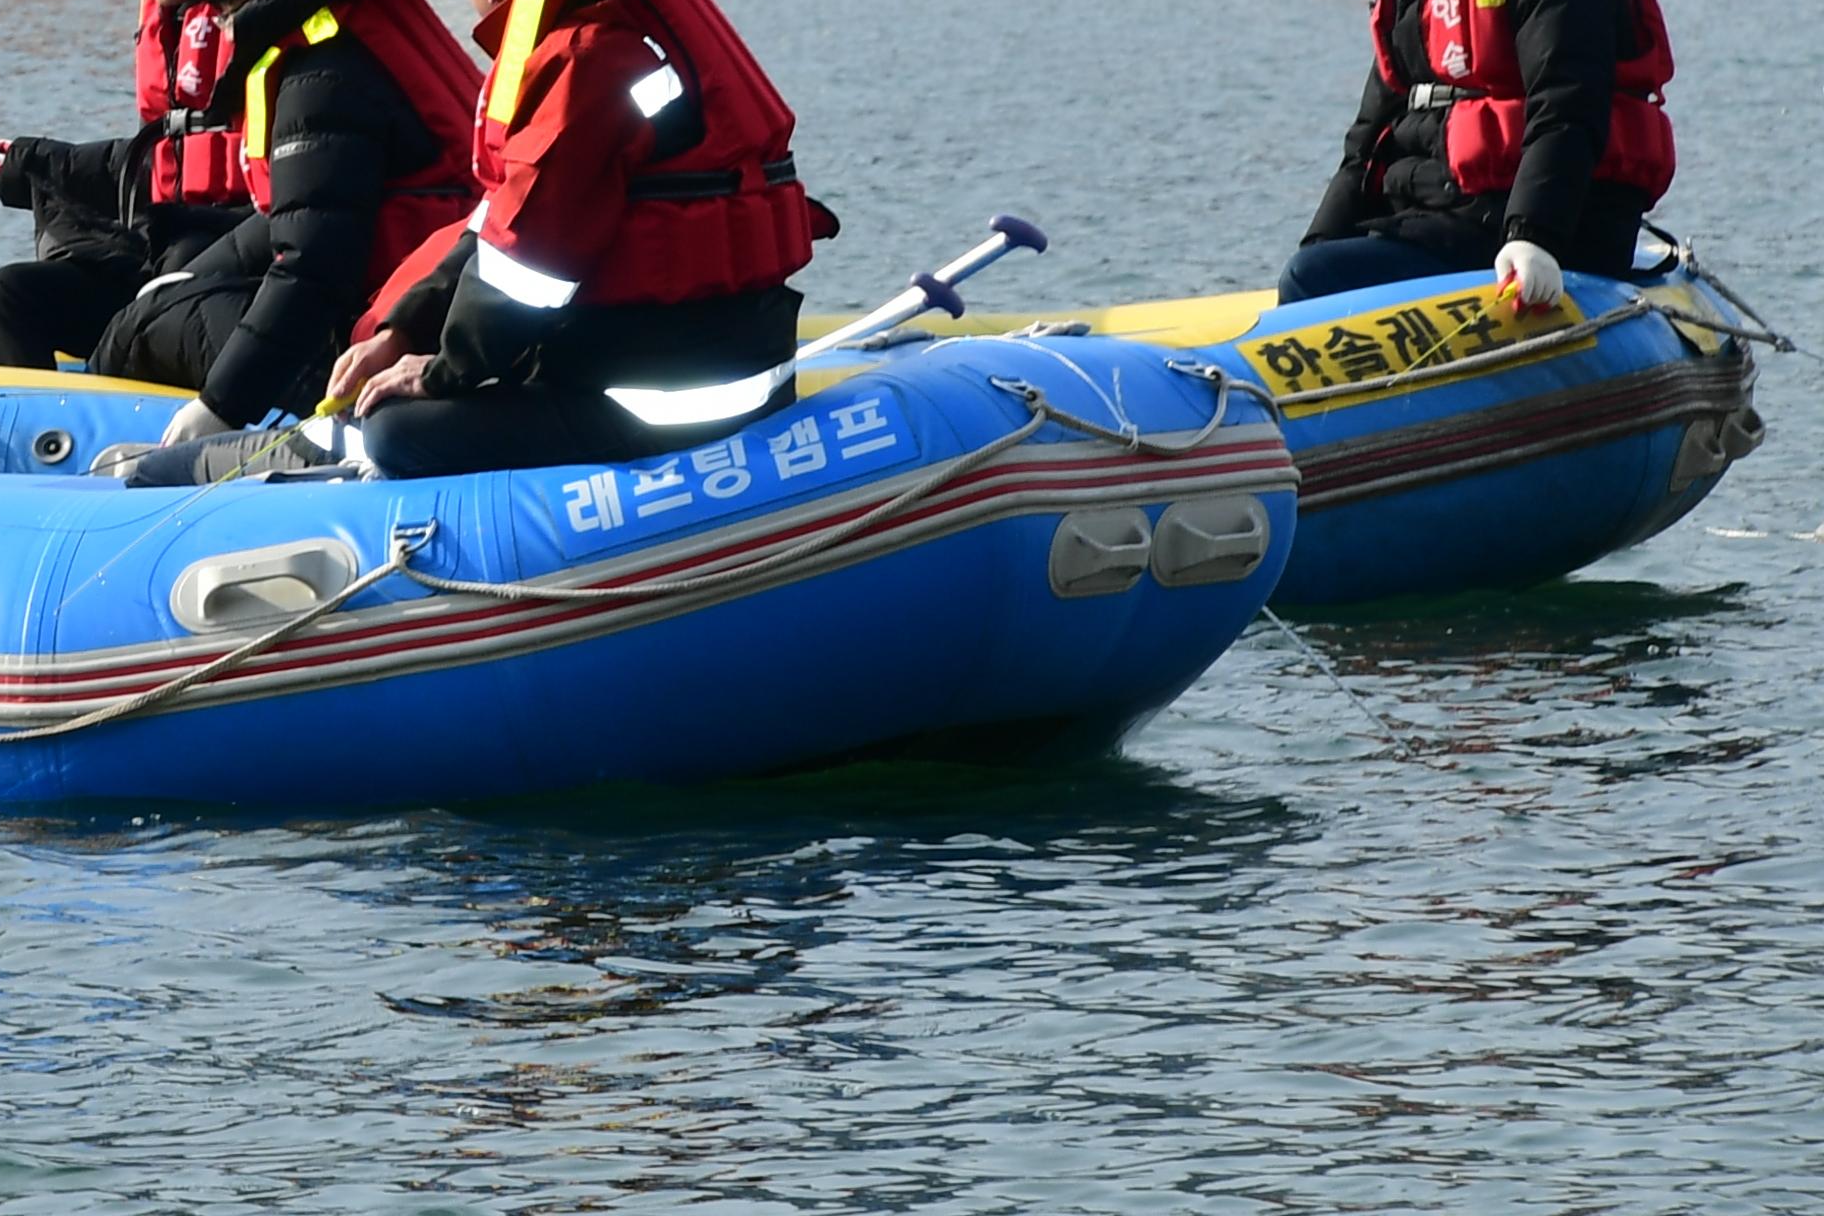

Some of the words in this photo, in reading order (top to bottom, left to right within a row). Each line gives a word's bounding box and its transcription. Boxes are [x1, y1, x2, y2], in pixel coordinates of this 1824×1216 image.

[177, 15, 213, 96] 한솔
[1257, 294, 1576, 402] 한솔레포
[563, 436, 752, 534] 래프팅
[769, 397, 898, 480] 캠프
